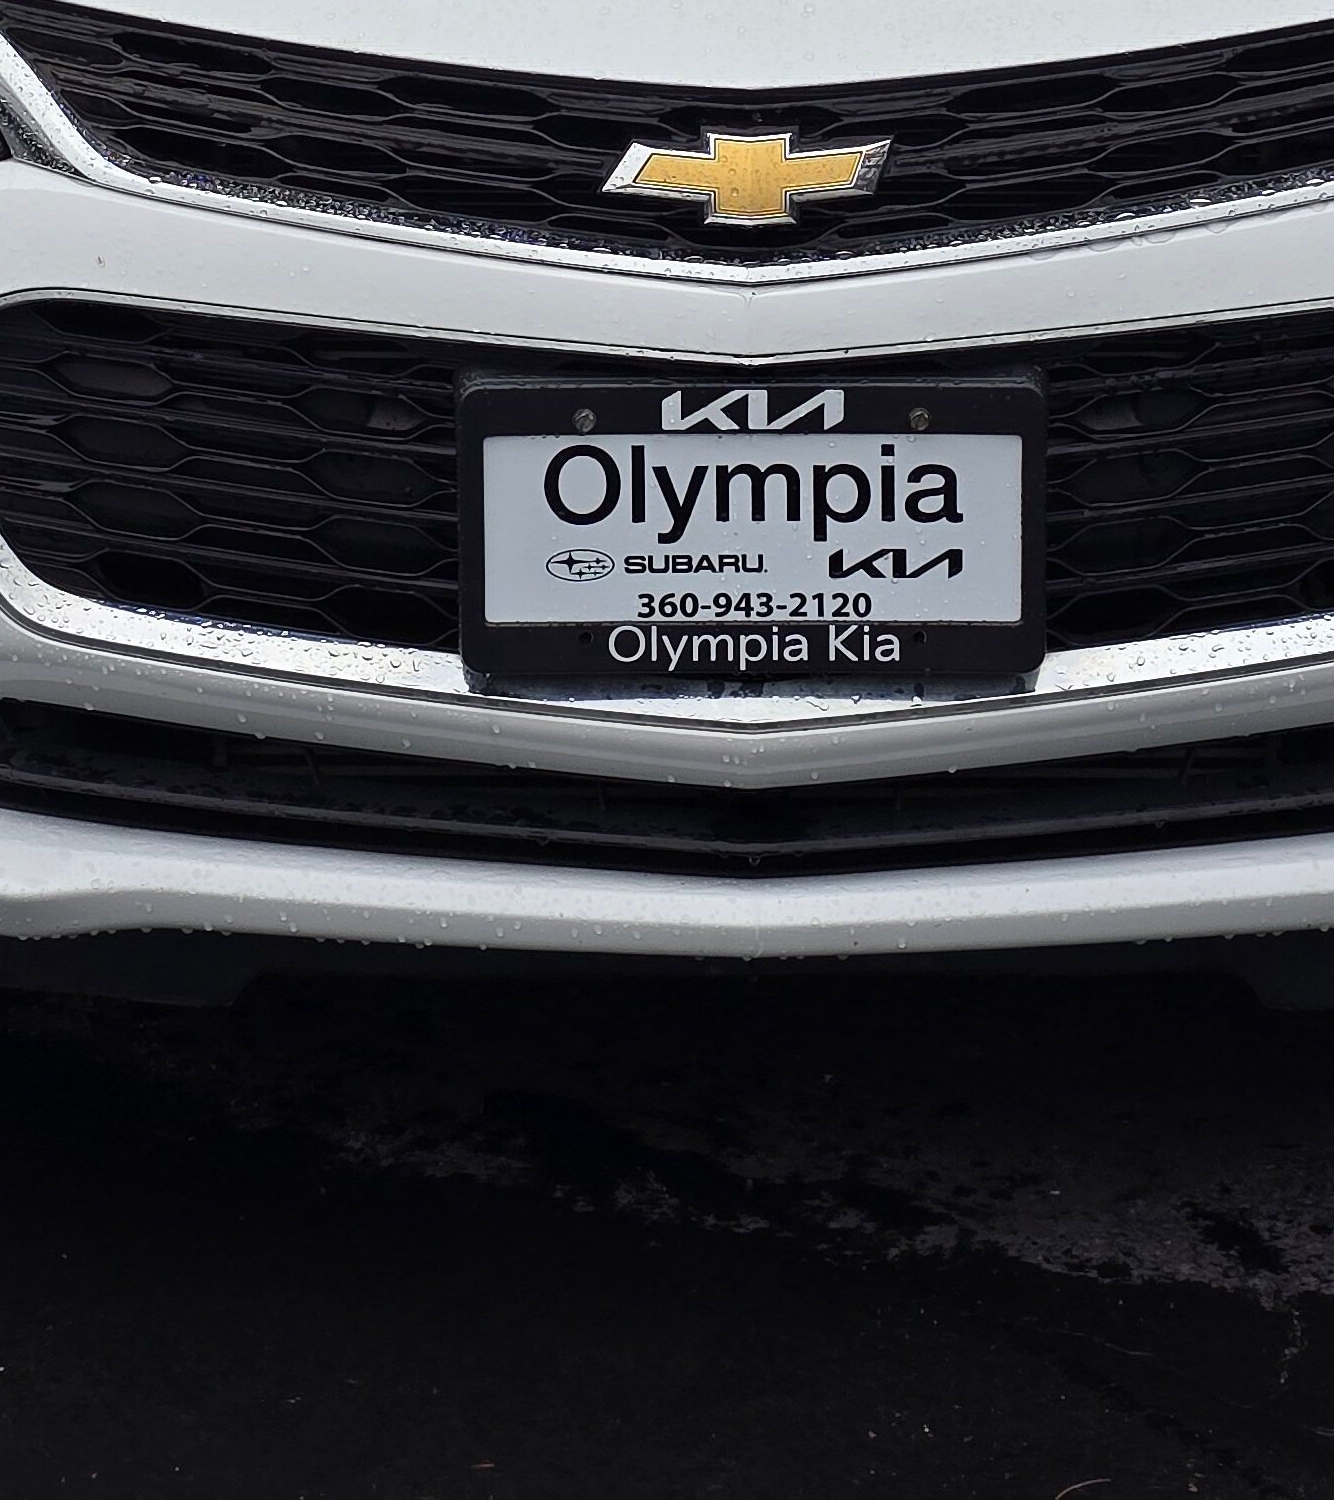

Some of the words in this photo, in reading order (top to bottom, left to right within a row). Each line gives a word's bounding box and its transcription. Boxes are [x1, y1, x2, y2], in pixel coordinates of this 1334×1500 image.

[661, 389, 845, 431] KIA
[543, 443, 964, 545] Olympia
[828, 548, 964, 579] KIA
[637, 592, 872, 619] 360-943-2120
[608, 625, 809, 672] Olympia
[828, 625, 900, 663] Kia
